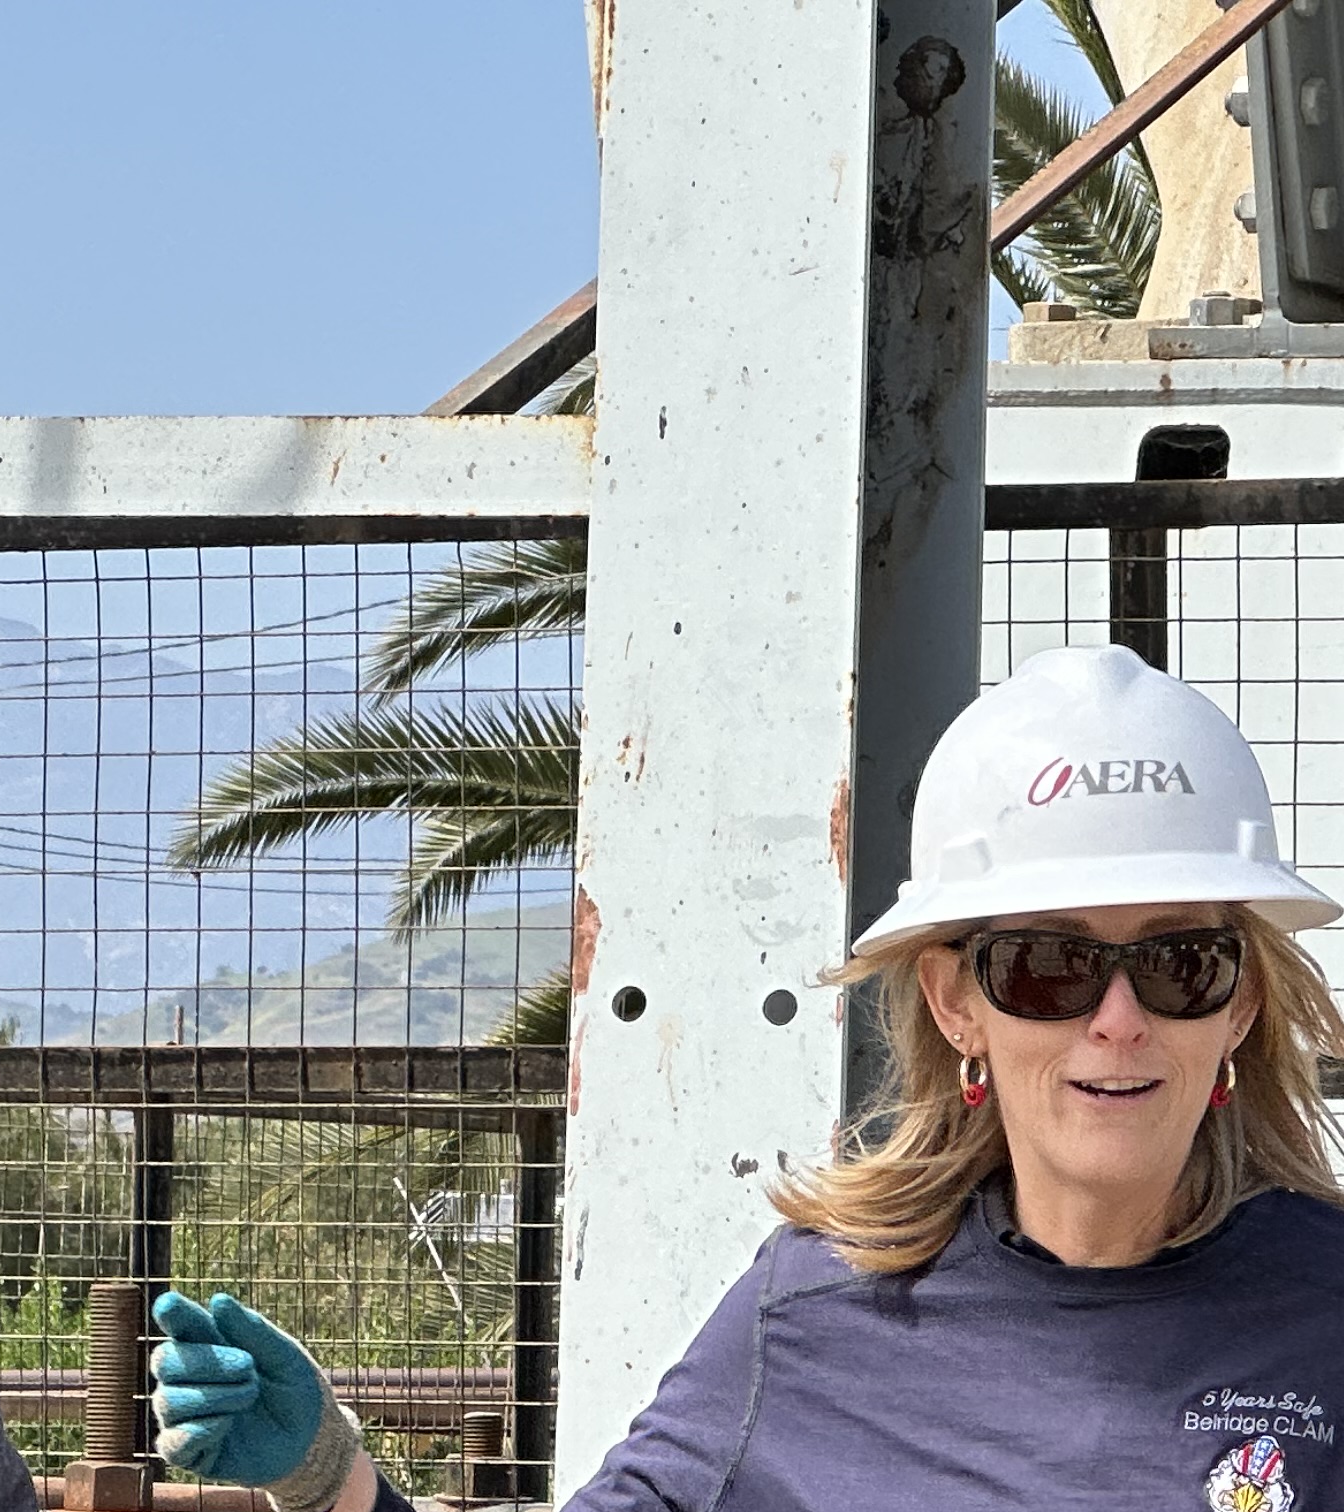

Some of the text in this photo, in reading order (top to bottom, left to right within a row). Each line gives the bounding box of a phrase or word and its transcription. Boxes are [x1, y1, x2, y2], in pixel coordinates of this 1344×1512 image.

[1060, 759, 1197, 799] AERA
[1220, 1388, 1276, 1411] Years
[1277, 1391, 1324, 1420] Safe
[1184, 1411, 1335, 1445] Belridge CLAM
